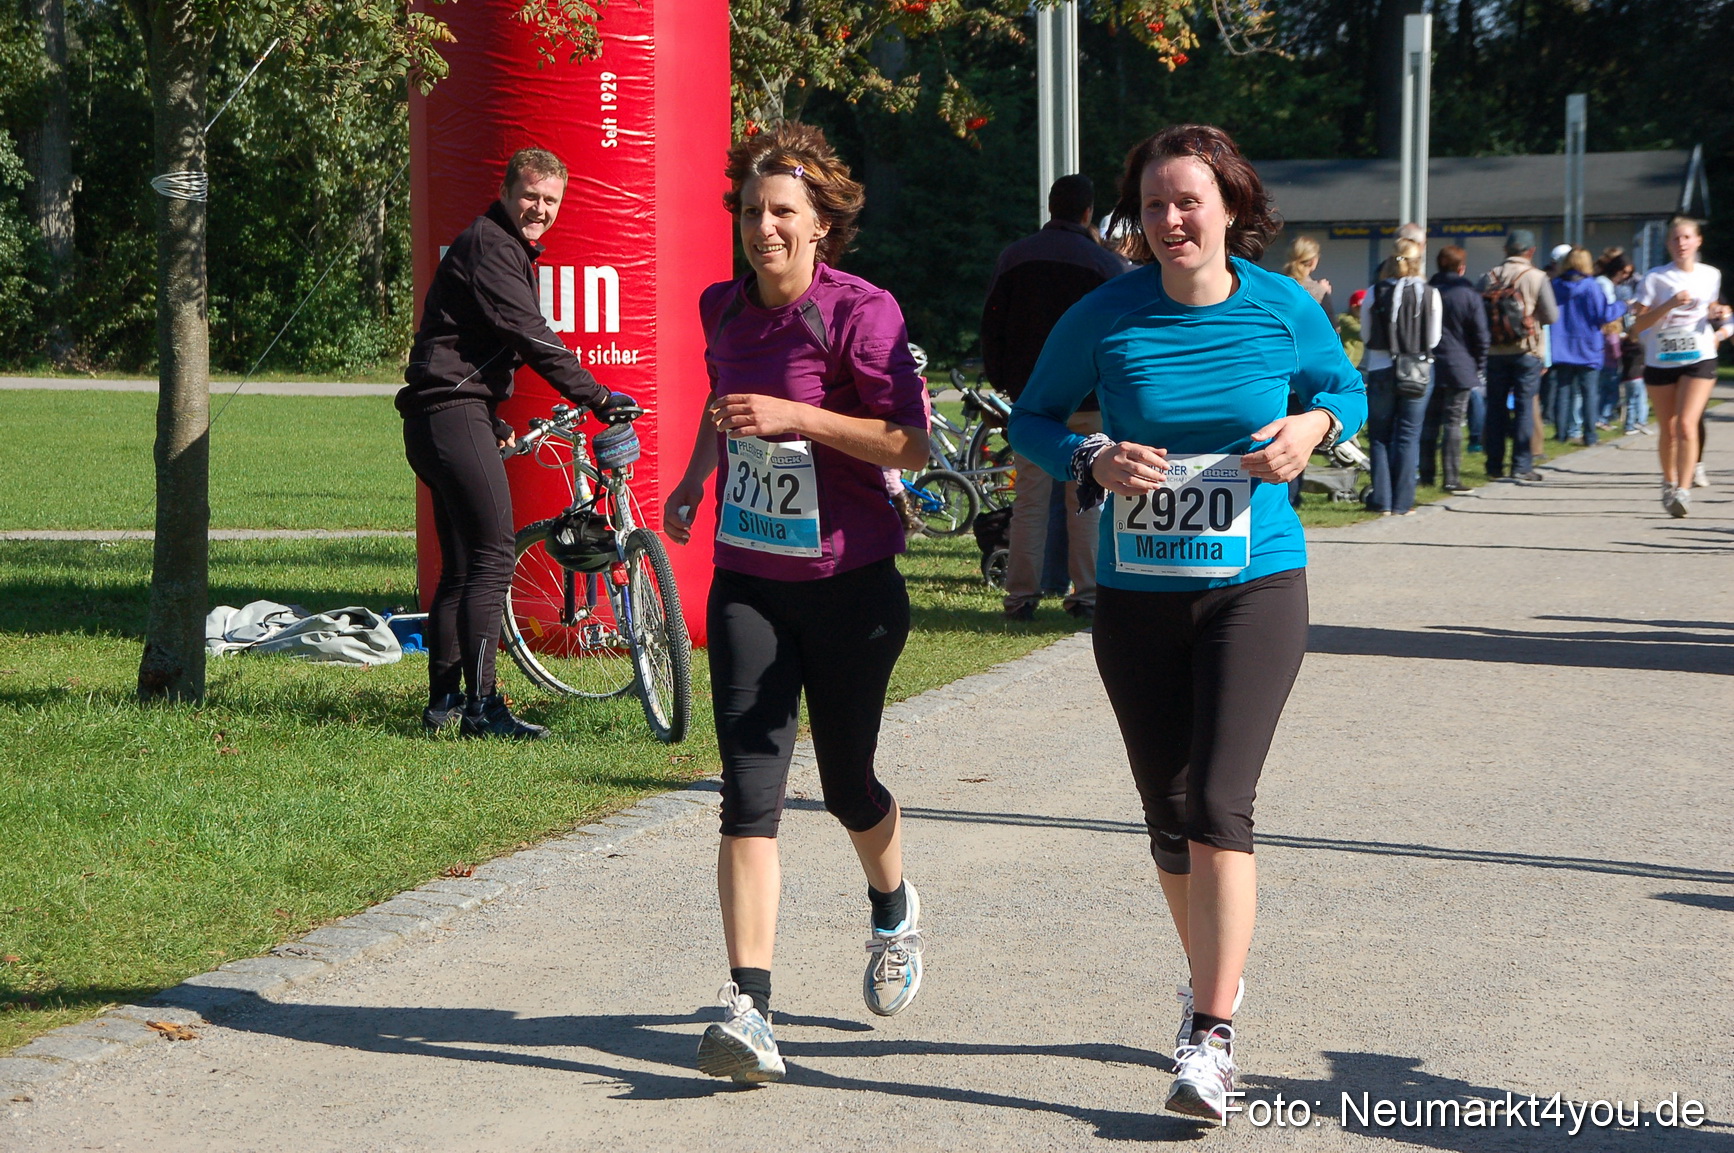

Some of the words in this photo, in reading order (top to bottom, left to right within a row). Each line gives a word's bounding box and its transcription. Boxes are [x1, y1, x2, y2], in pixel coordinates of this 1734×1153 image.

[600, 71, 618, 112] 1929
[601, 117, 618, 148] Seit
[538, 265, 620, 334] un
[588, 341, 640, 365] sicher
[732, 460, 802, 515] 3112
[1202, 468, 1239, 478] BOCK
[738, 509, 787, 540] Silvia
[1126, 487, 1234, 532] 2920
[1135, 535, 1223, 561] Martina
